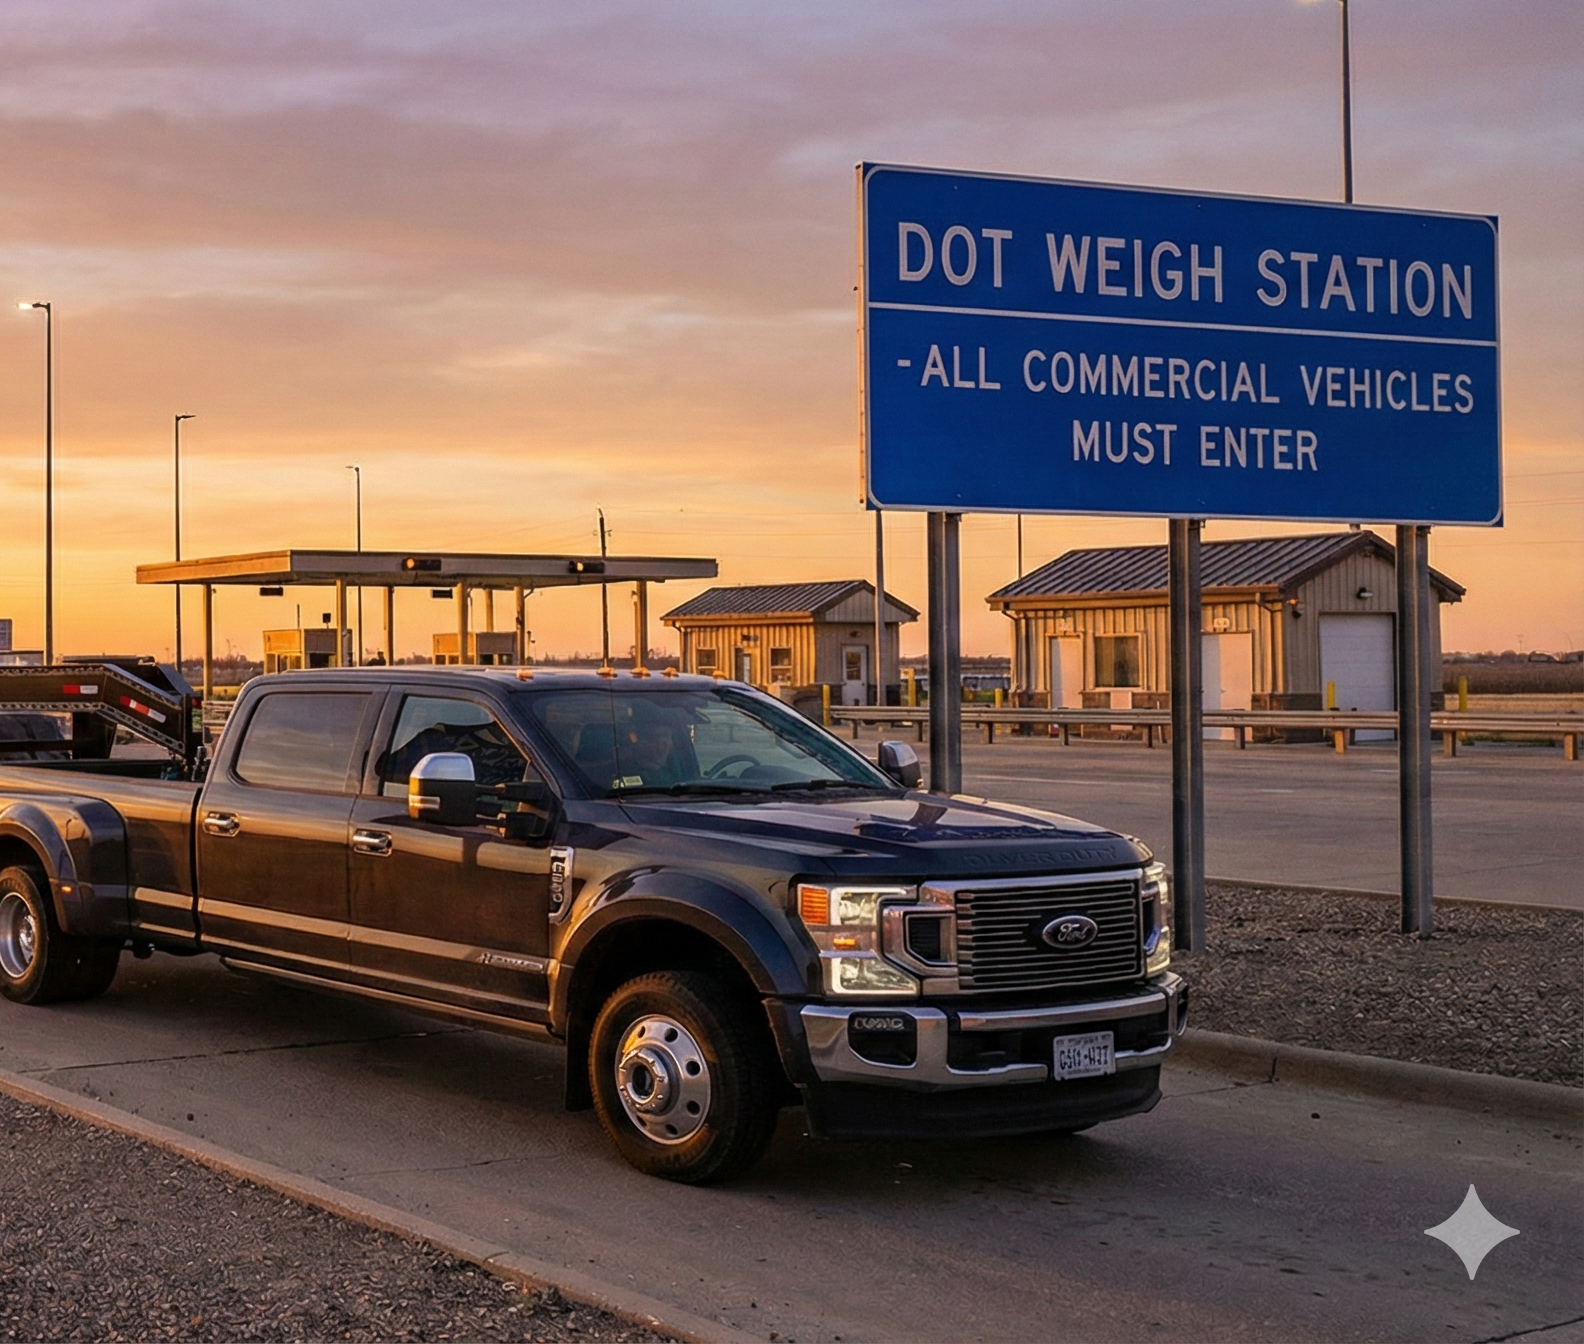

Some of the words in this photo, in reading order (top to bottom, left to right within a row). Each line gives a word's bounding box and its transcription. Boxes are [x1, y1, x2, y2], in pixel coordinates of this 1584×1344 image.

[898, 221, 1013, 288] DOT
[1046, 233, 1223, 303] WEIGH
[1256, 249, 1473, 319] STATION
[1023, 349, 1280, 404] COMMERCIAL
[1300, 365, 1474, 414] VEHICLES
[1073, 419, 1178, 465] MUST
[1200, 425, 1318, 471] ENTER
